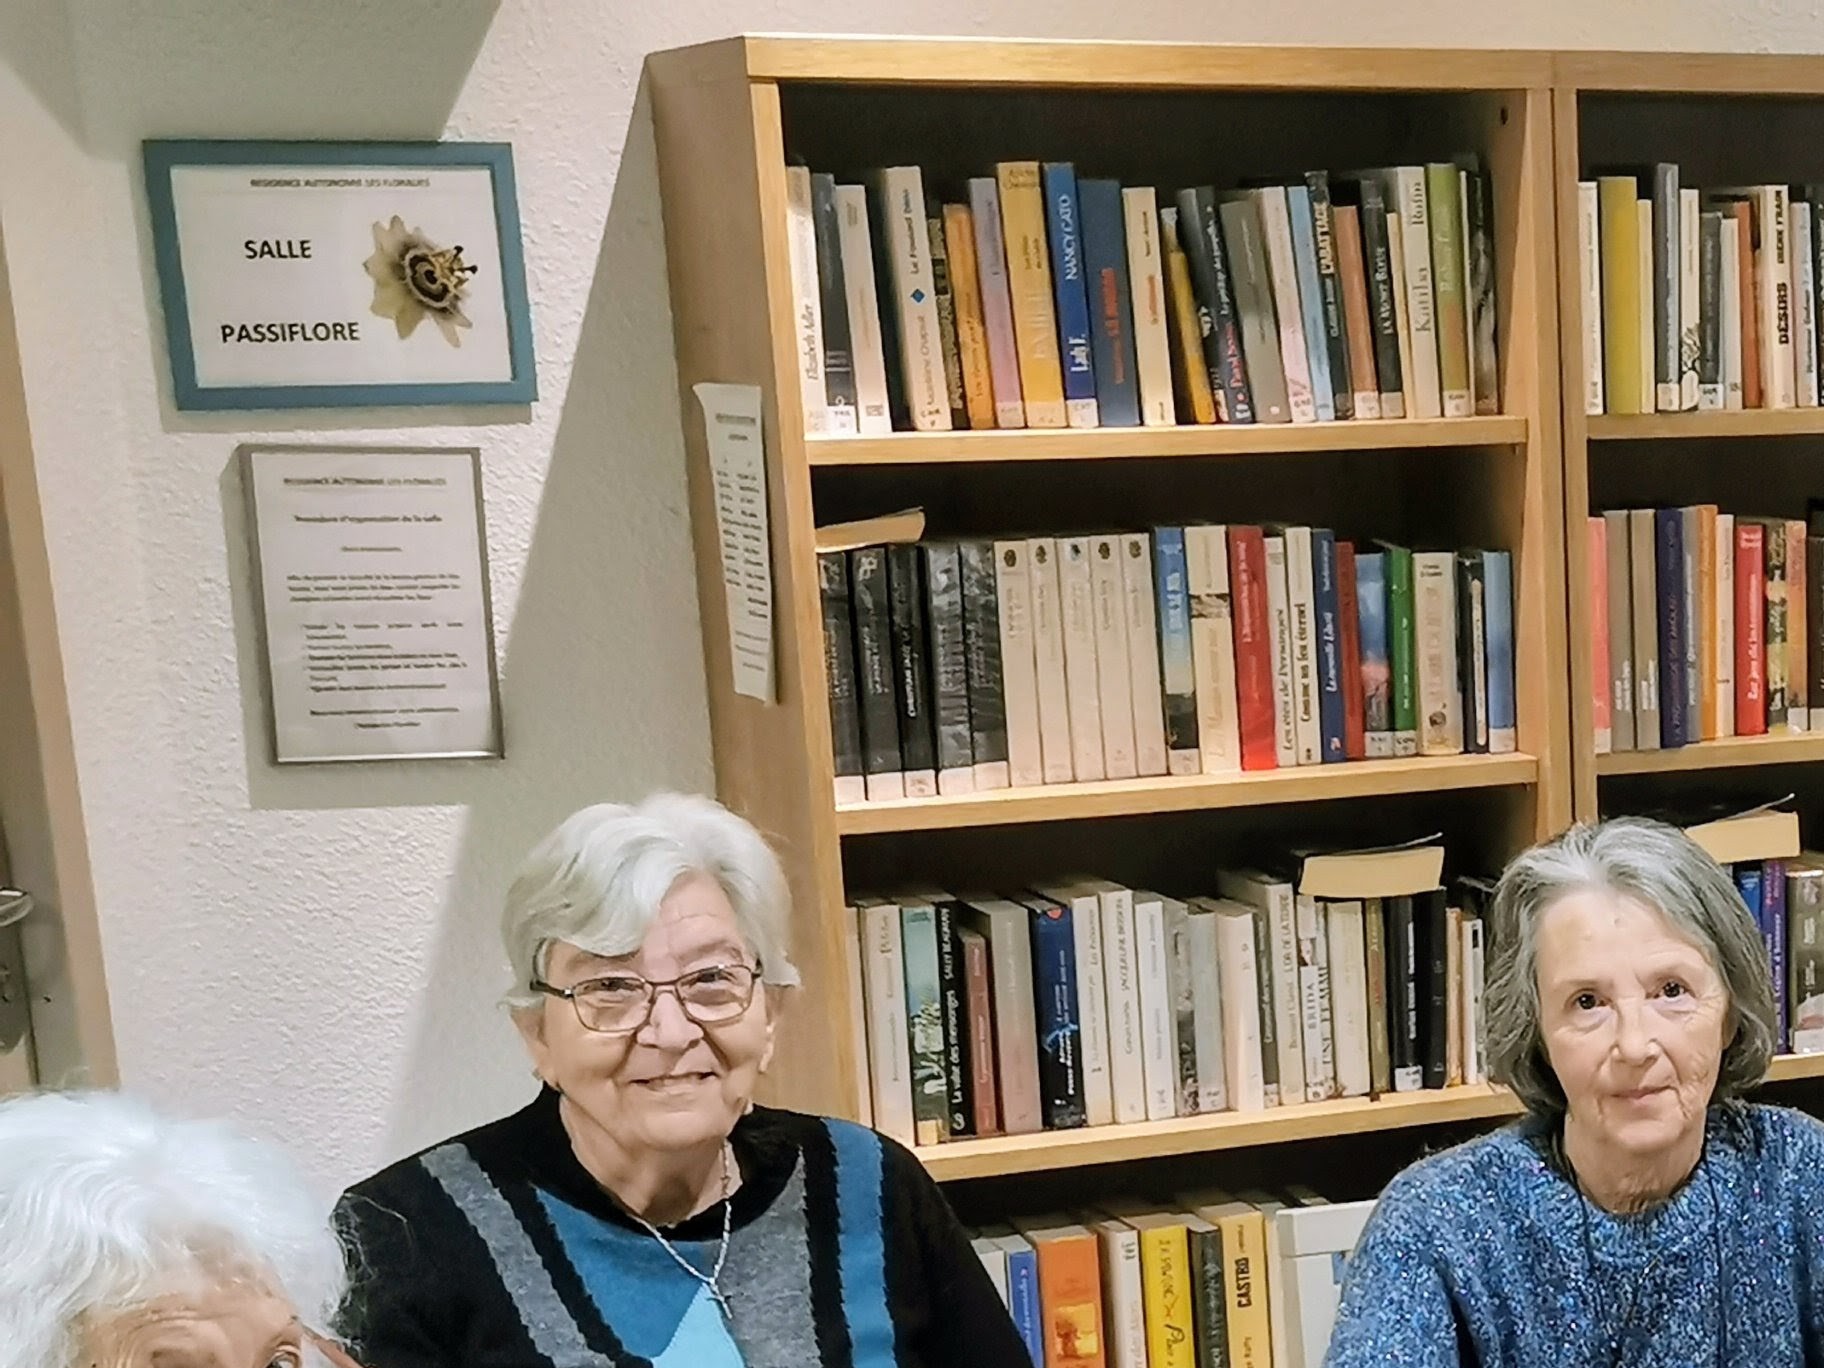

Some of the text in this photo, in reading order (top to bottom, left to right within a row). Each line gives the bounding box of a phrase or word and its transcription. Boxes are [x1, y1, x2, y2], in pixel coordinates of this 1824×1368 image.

[244, 239, 312, 260] SALLE
[1057, 194, 1078, 280] NANCY CATO
[1413, 267, 1432, 333] Katiba
[1775, 282, 1789, 345] DÉSIRS
[221, 321, 361, 345] PASSIFLORE
[1276, 680, 1289, 698] de
[1280, 727, 1293, 750] Les
[945, 990, 959, 1044] mensonges
[1304, 982, 1318, 1030] BRIDA
[948, 1046, 960, 1063] des
[952, 1089, 963, 1103] La
[1235, 1257, 1252, 1308] CASTRO
